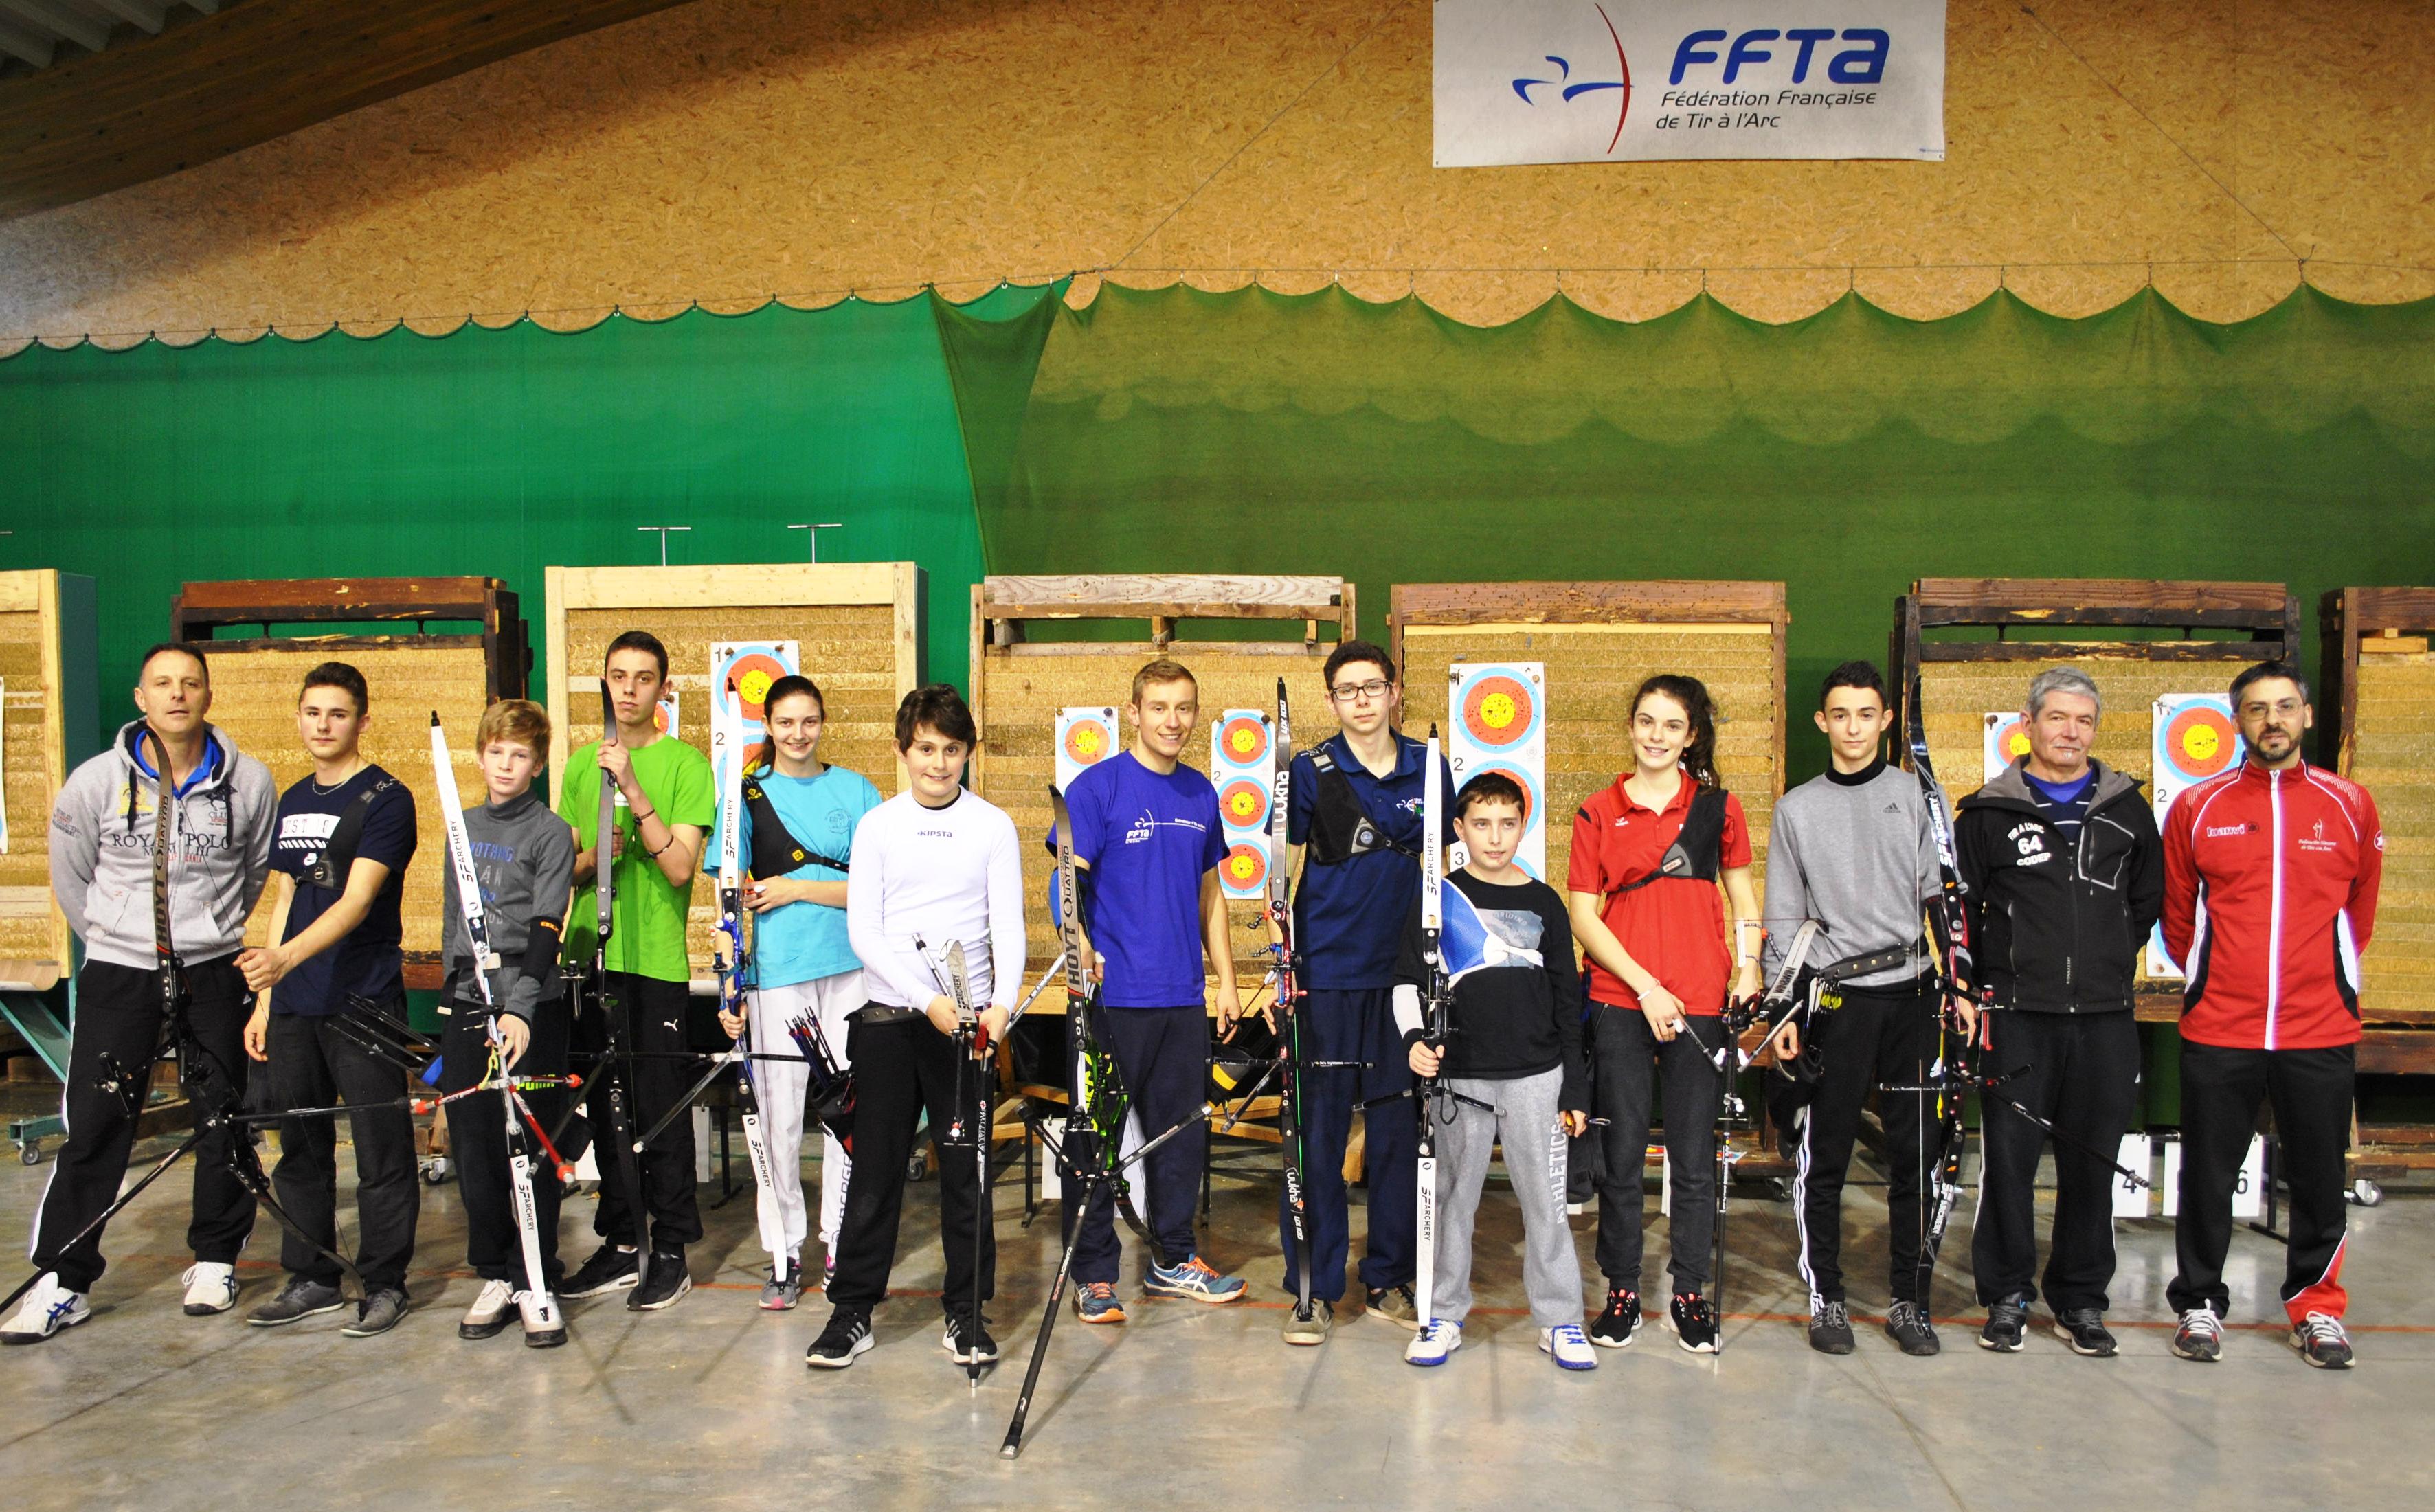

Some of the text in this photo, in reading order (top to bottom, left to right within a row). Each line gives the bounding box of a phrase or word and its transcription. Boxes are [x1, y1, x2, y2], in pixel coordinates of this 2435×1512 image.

[1661, 90, 1876, 110] Fédération Française
[1655, 112, 1780, 129] de Tir à l'Arc
[715, 732, 725, 745] 2
[1454, 757, 1463, 771] 2
[1213, 771, 1221, 781] 2
[2157, 789, 2167, 803] 2
[2018, 835, 2043, 855] 64
[1455, 852, 1464, 866] 3
[2017, 852, 2052, 866] CODEP
[155, 796, 169, 943] HOYT QUATTRO
[1063, 846, 1080, 986] HOYT QUATTRO
[2122, 1169, 2137, 1194] 4
[2235, 1169, 2249, 1195] 6
